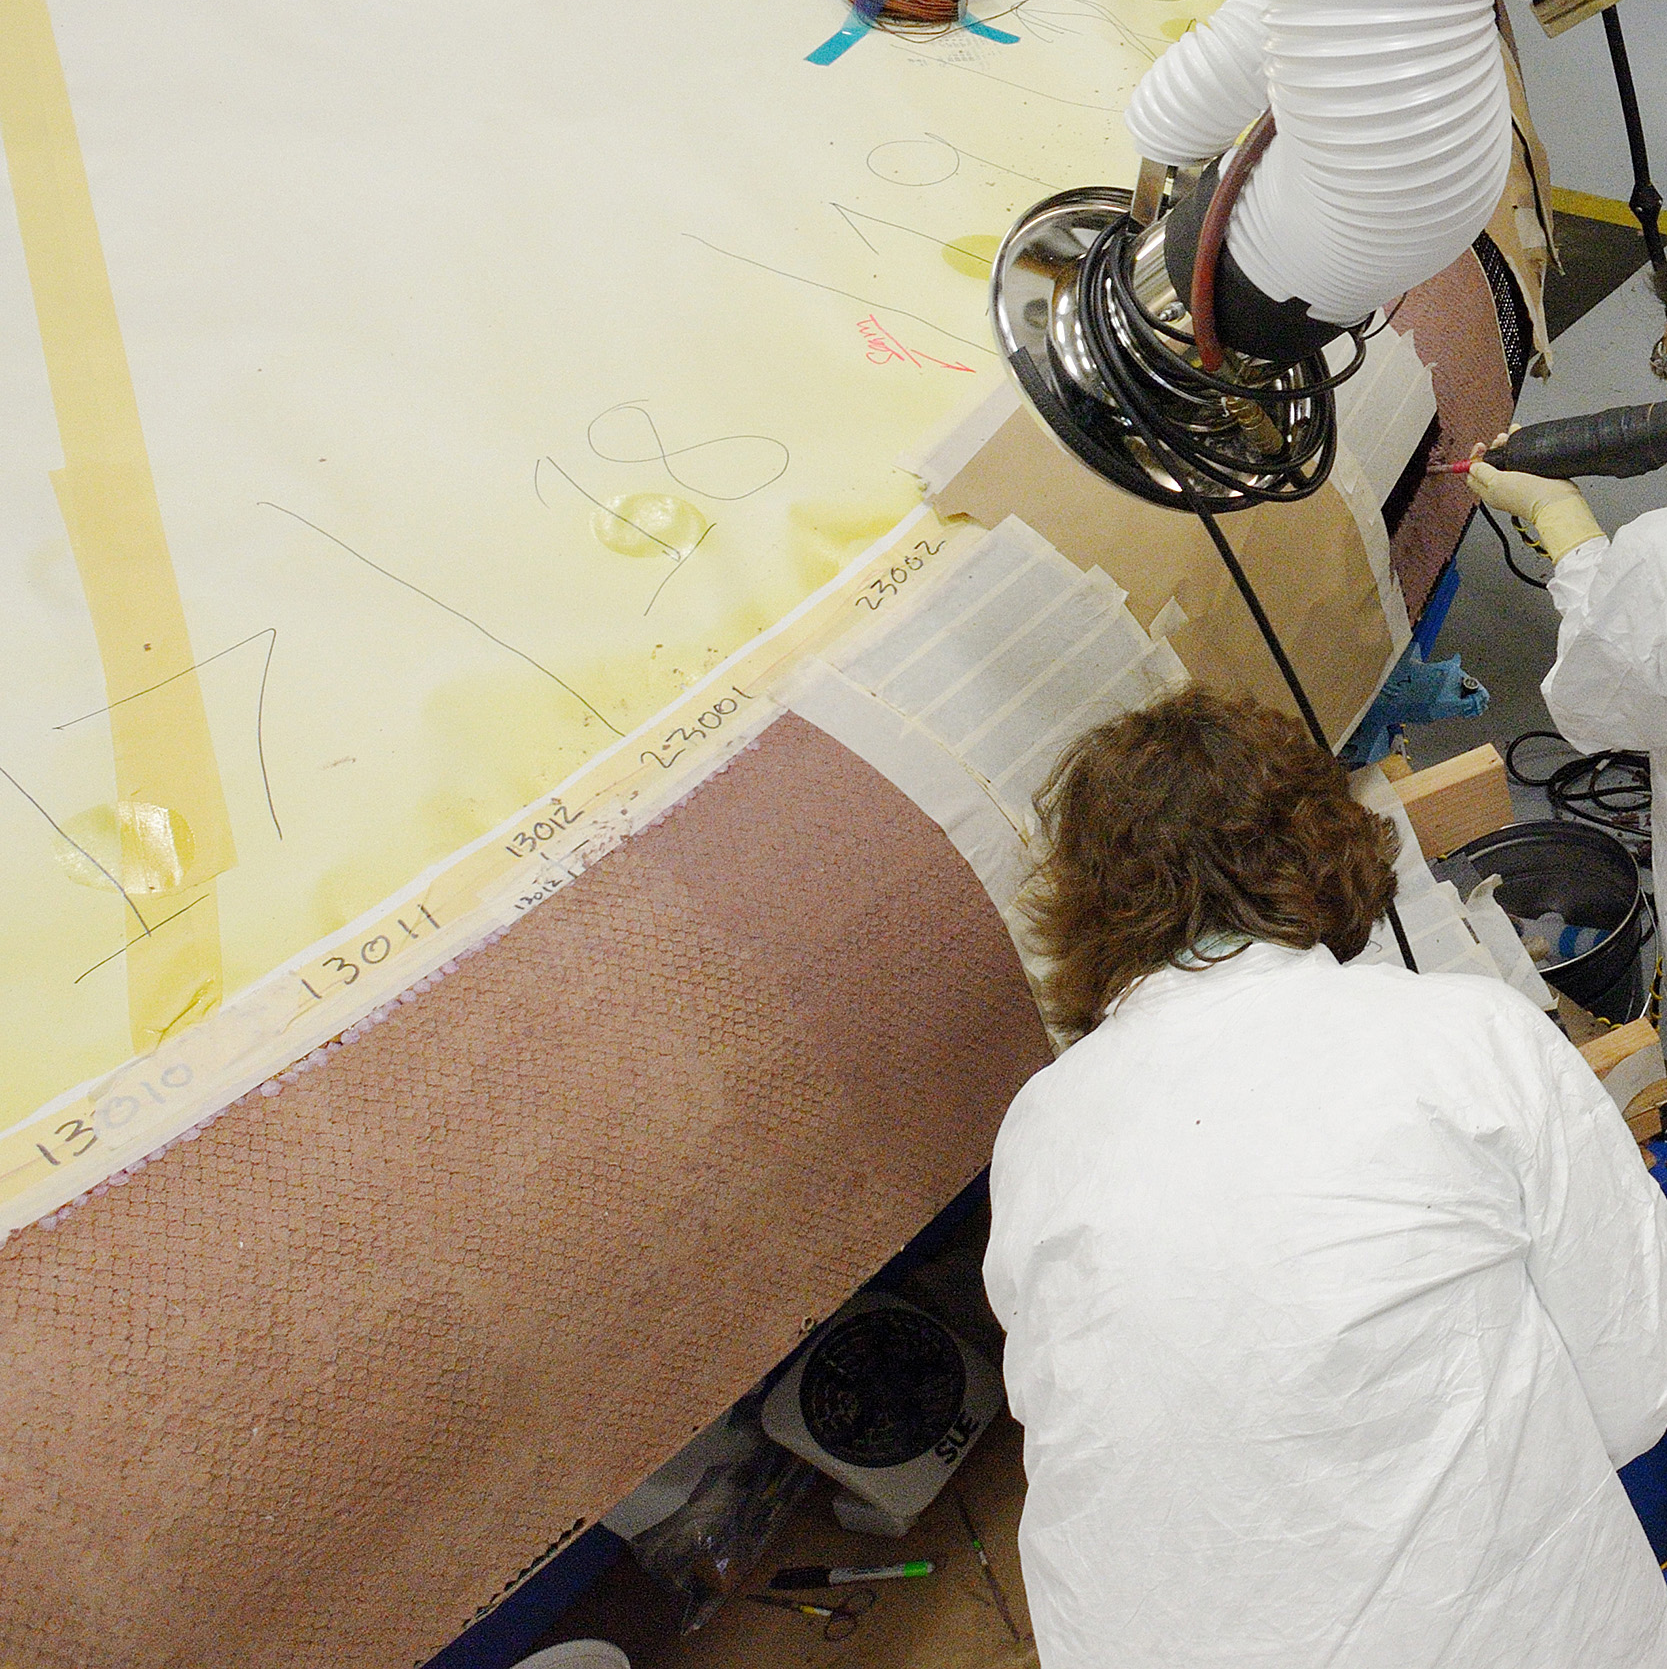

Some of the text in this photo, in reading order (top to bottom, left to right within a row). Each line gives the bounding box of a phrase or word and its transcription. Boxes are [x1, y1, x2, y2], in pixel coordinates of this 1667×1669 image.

[855, 540, 947, 611] 23002
[640, 686, 757, 770] 23001
[505, 805, 585, 858] 13012
[301, 904, 441, 1000] 13011
[36, 1063, 195, 1166] 13010
[934, 1408, 979, 1467] SUE
